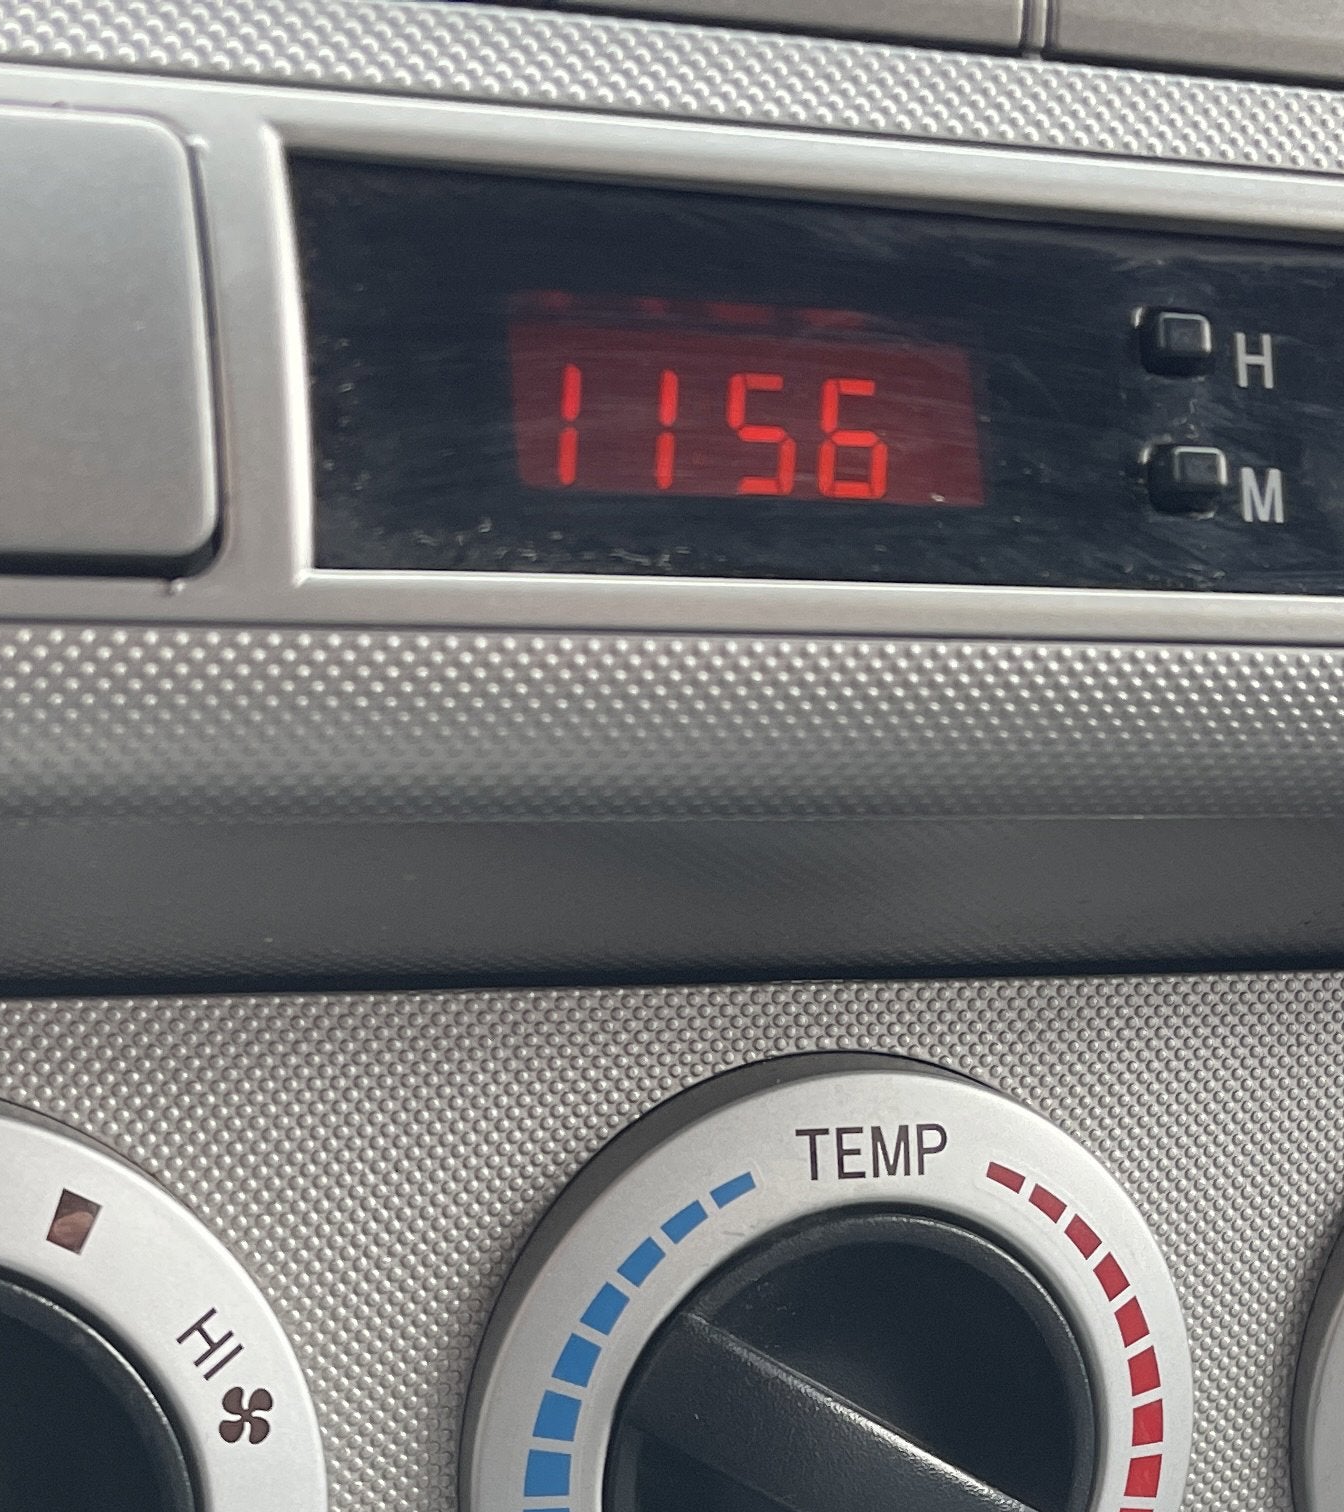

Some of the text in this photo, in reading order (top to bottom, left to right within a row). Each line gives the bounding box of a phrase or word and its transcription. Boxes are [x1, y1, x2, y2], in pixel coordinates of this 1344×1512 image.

[1234, 332, 1274, 389] H
[1240, 467, 1285, 523] M
[794, 1122, 949, 1182] TEMP
[176, 1307, 245, 1381] HI
